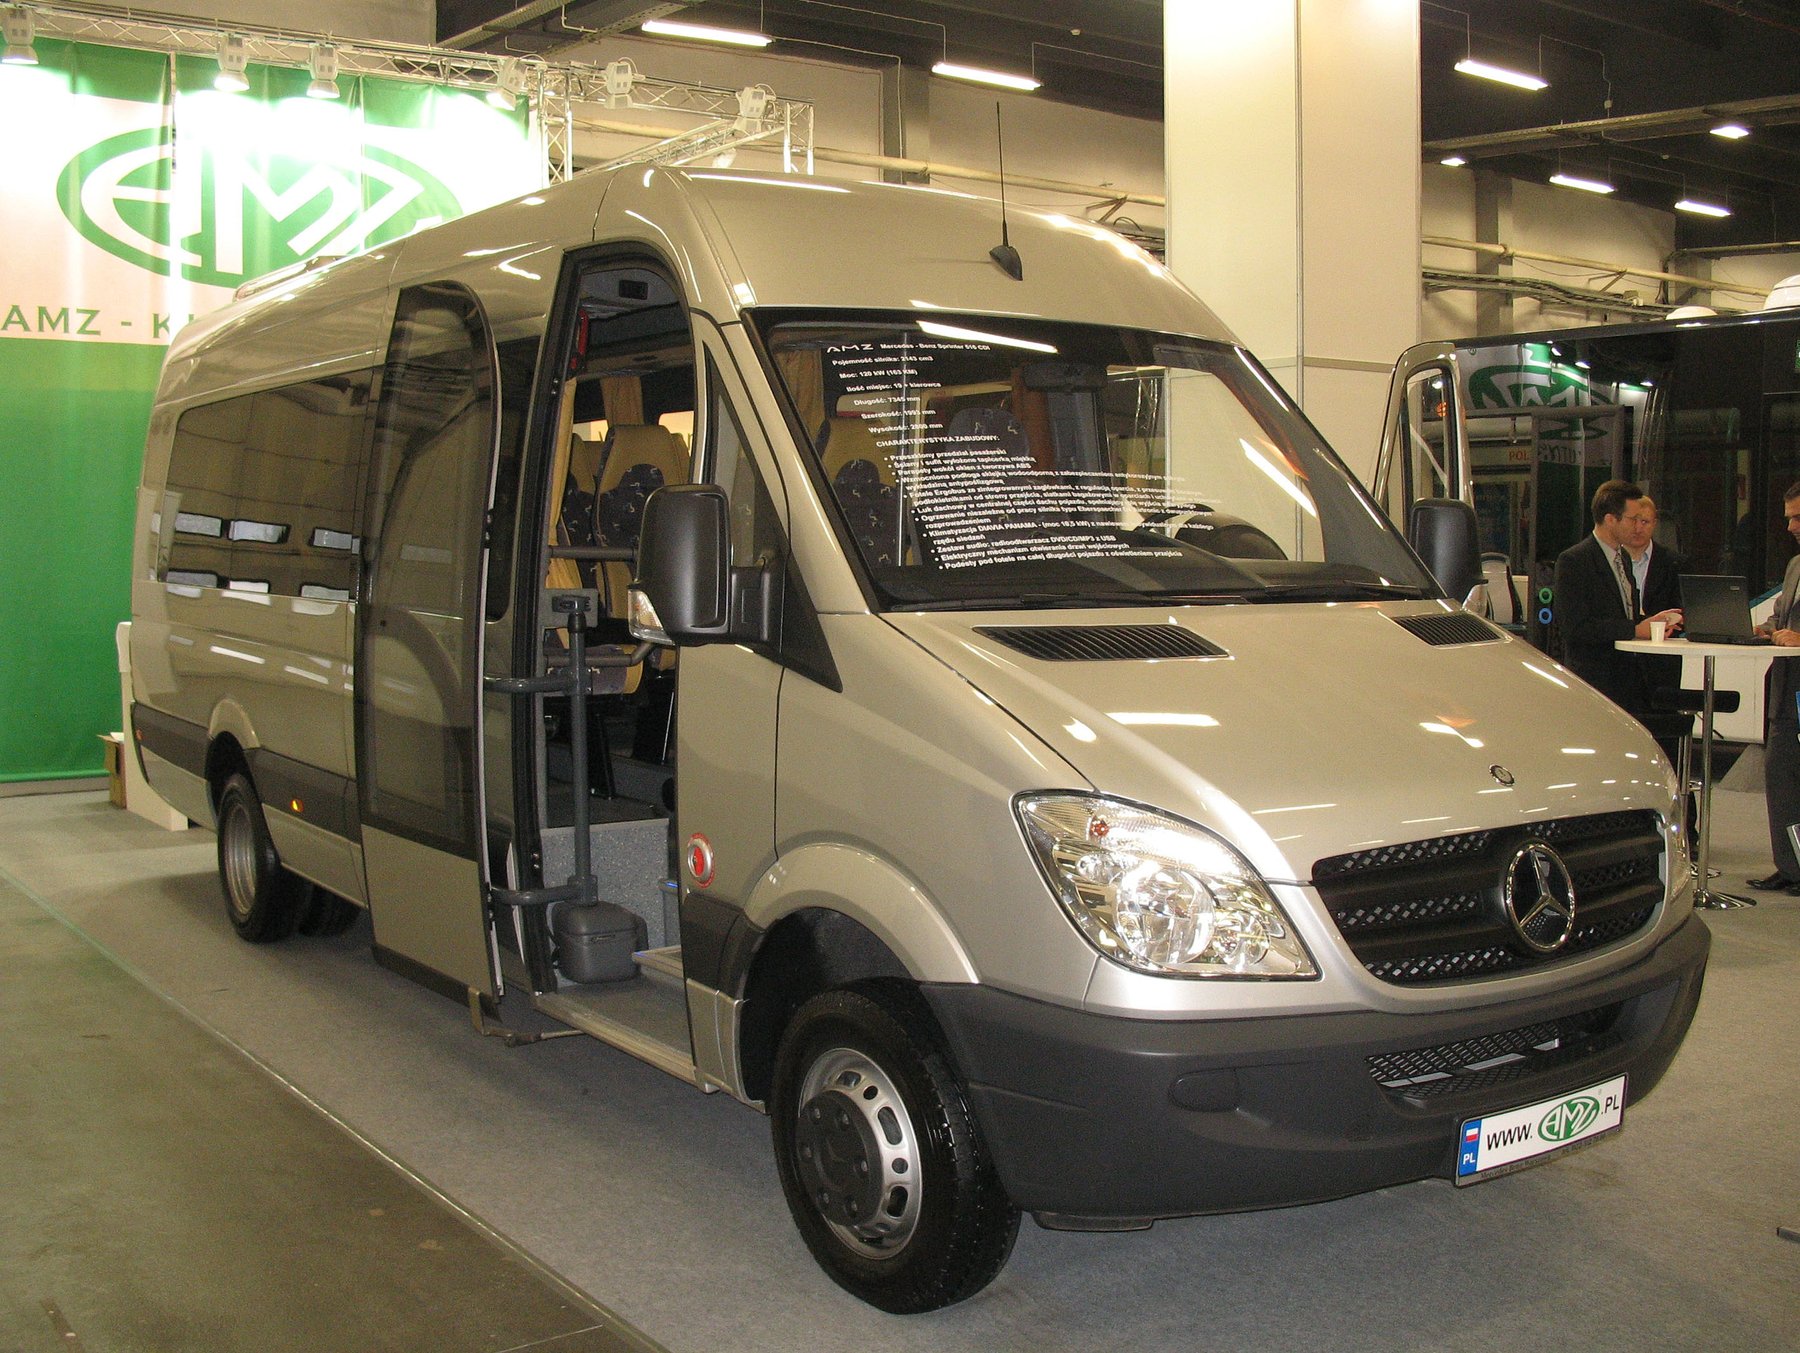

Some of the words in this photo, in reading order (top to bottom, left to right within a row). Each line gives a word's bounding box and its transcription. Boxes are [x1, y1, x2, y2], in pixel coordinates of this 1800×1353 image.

[1, 304, 101, 337] AMZ
[827, 343, 874, 354] AMZ
[832, 357, 874, 367] Pojemność
[846, 385, 866, 393] Ilość
[866, 383, 893, 391] miejsc:
[853, 397, 888, 406] Długość:
[860, 410, 903, 420] Szerokość:
[868, 424, 910, 434] Wysokość:
[876, 436, 955, 448] CHARAKTERYSTYKA
[890, 452, 935, 461] Przeszklony
[935, 450, 969, 458] przedział
[969, 448, 1007, 456] pasażerski
[893, 461, 919, 469] Ściany
[942, 457, 977, 465] wyłożone
[897, 467, 932, 475] Parapety
[900, 474, 951, 483] Wzmocniona
[950, 472, 981, 480] podłoga
[905, 482, 949, 491] wykładziną
[908, 491, 934, 499] Fotele
[976, 485, 1033, 493] zintegrowanymi
[913, 495, 973, 507] podłokietnikami
[976, 500, 1013, 508] centralnej
[921, 512, 966, 522] Ogrzewanie
[966, 508, 1006, 517] niezależne
[925, 518, 992, 529] rozprowadzeniem
[928, 526, 978, 537] Klimatyzacja
[977, 524, 1005, 532] DIAVIA
[1004, 521, 1038, 529] PANAMA
[1042, 521, 1061, 529] (moc
[1075, 520, 1091, 528] kW)
[933, 537, 955, 546] rzędu
[955, 534, 986, 543] siedzeń
[937, 545, 965, 553] Zestaw
[966, 542, 991, 550] audio:
[991, 538, 1051, 547] radioodtwarzacz
[940, 551, 986, 561] Elektryczny
[986, 547, 1030, 556] mechanizm
[1029, 544, 1067, 552] otwierania
[944, 560, 977, 570] Podesty
[978, 558, 994, 566] pod
[993, 555, 1016, 564] fotele
[1027, 553, 1046, 561] całej
[1045, 551, 1077, 560] długości
[1153, 550, 1184, 558] przejścia
[1539, 1096, 1599, 1141] AMZ
[1462, 1152, 1476, 1165] PL
